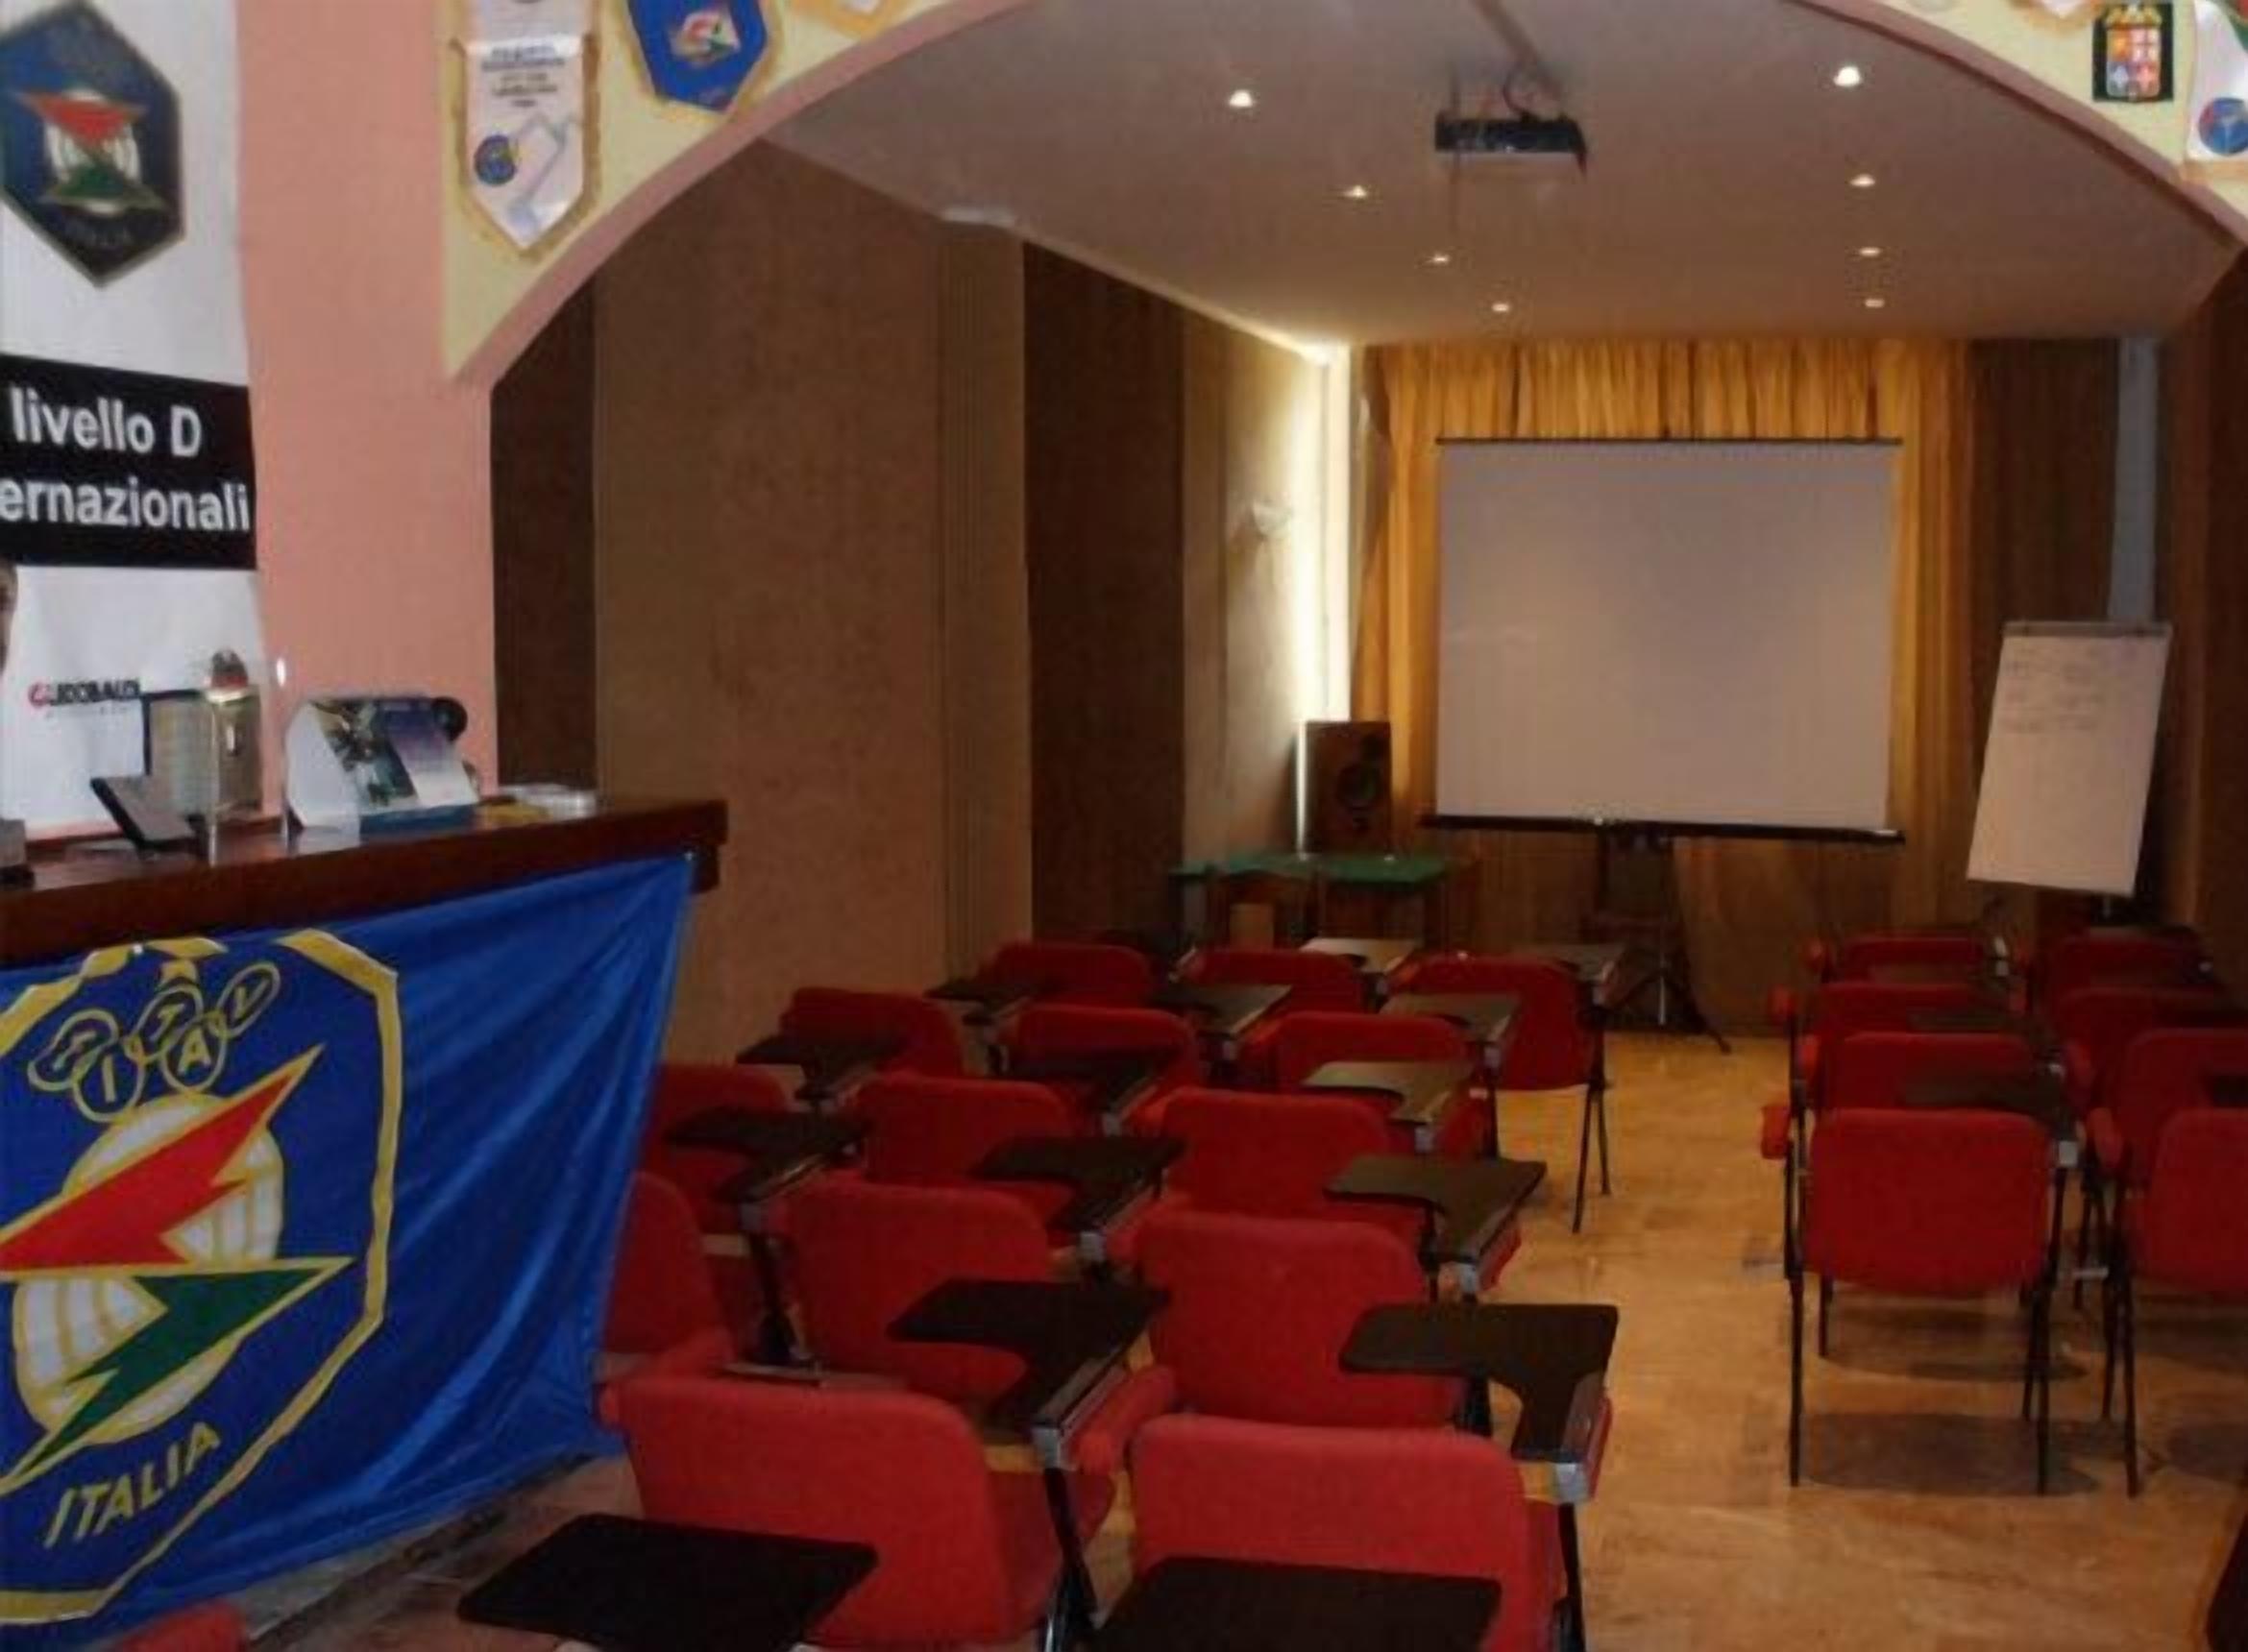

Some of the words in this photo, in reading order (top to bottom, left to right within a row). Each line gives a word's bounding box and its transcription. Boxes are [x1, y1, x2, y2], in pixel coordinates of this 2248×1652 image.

[11, 386, 156, 454] livello
[170, 404, 202, 458] D
[0, 475, 250, 531] ernazionali
[43, 1421, 222, 1549] ITALIA
